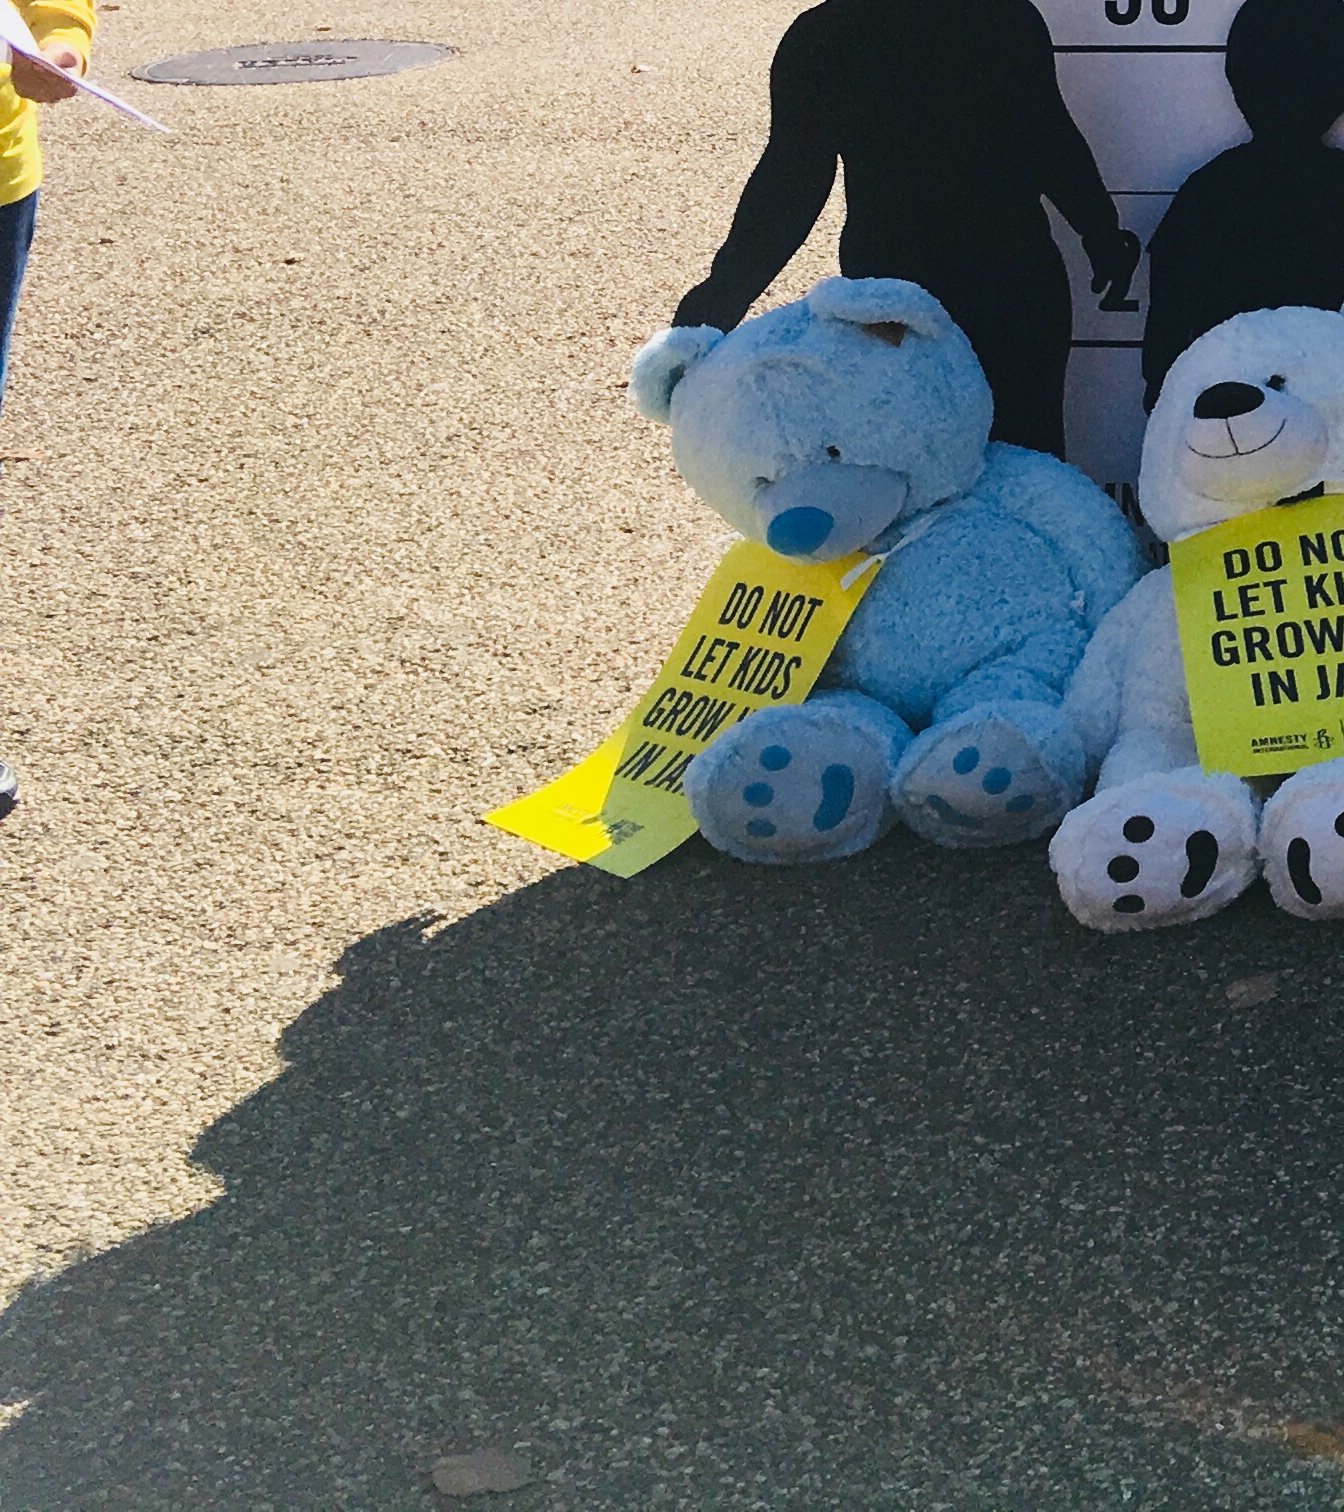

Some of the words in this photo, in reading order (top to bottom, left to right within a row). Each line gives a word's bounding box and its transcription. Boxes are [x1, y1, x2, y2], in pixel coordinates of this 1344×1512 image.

[1223, 541, 1283, 580] DO
[718, 582, 764, 629] DO
[758, 590, 824, 642] NOT
[1213, 579, 1287, 622] LET
[1211, 615, 1344, 667] GROW
[680, 635, 740, 683] LET
[728, 646, 802, 700] KIDS
[1251, 669, 1299, 706] IN
[642, 687, 737, 742] GROW
[1251, 734, 1307, 748] AMNESTY
[614, 741, 667, 781] IN
[643, 750, 696, 797] JA
